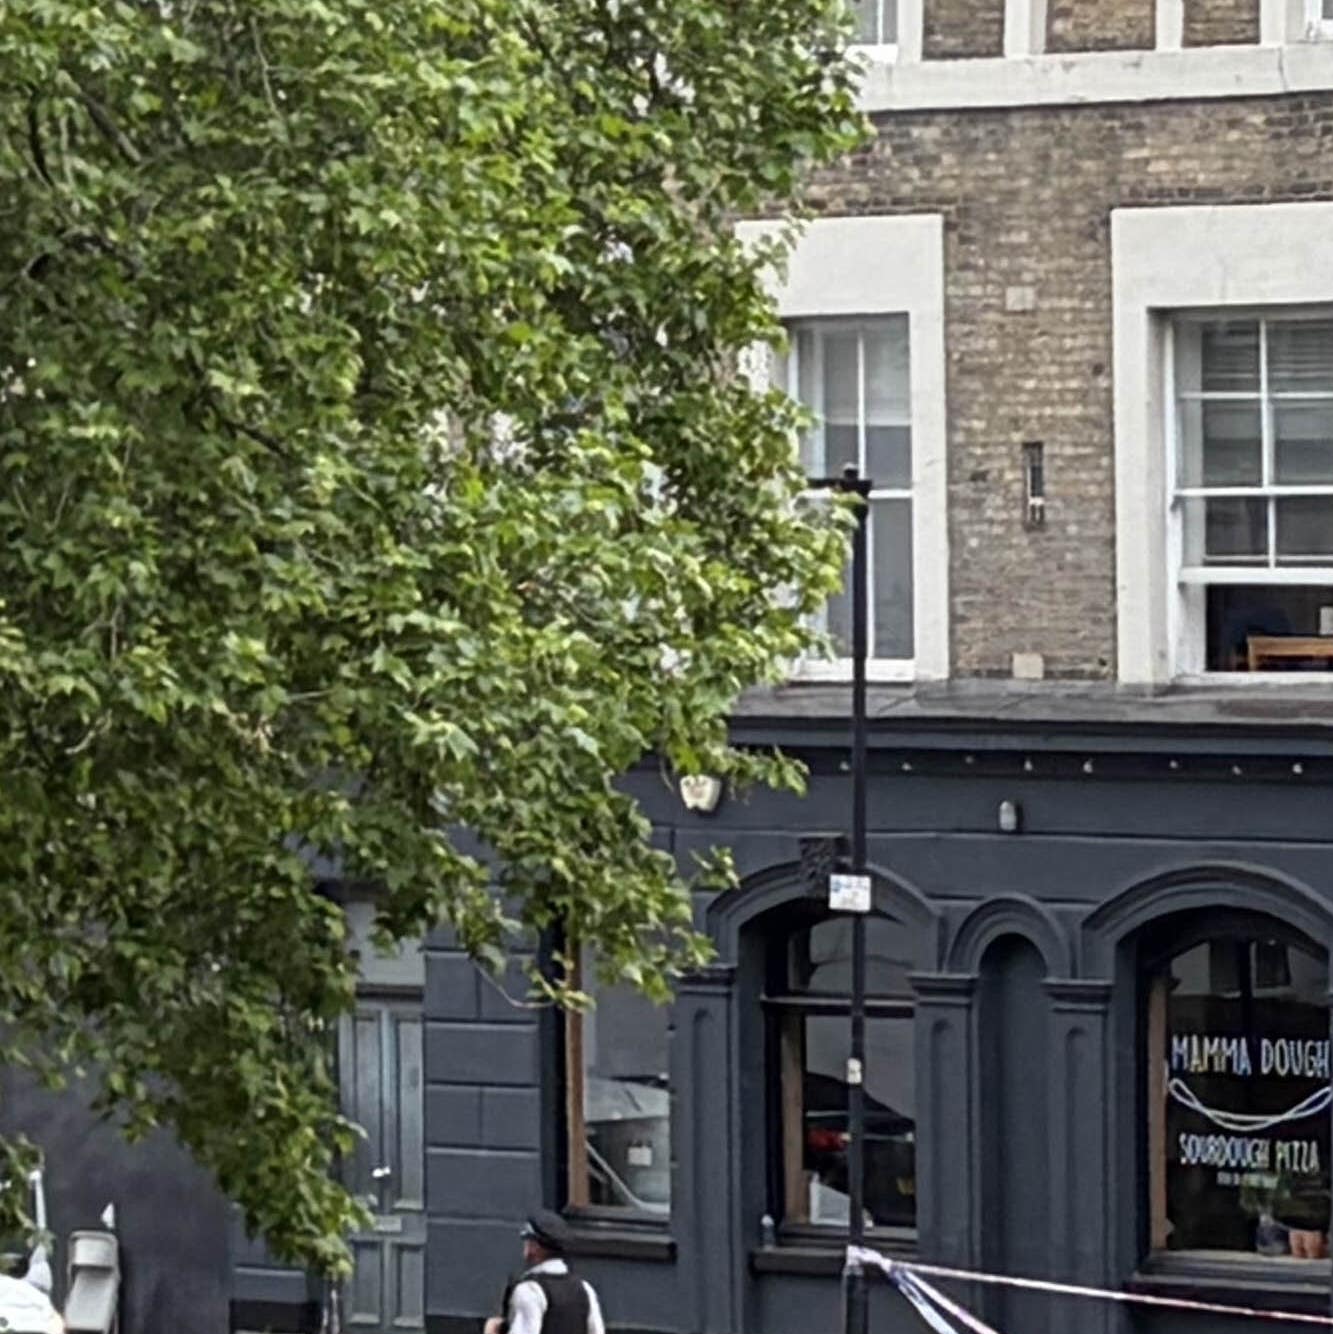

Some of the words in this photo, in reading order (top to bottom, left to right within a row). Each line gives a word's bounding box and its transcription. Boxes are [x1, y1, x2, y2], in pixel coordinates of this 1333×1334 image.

[1171, 1034, 1252, 1075] MAMMA
[1260, 1038, 1330, 1078] DOUGH
[1179, 1132, 1270, 1168] SOURDOUGH
[1275, 1139, 1320, 1173] PIZZA
